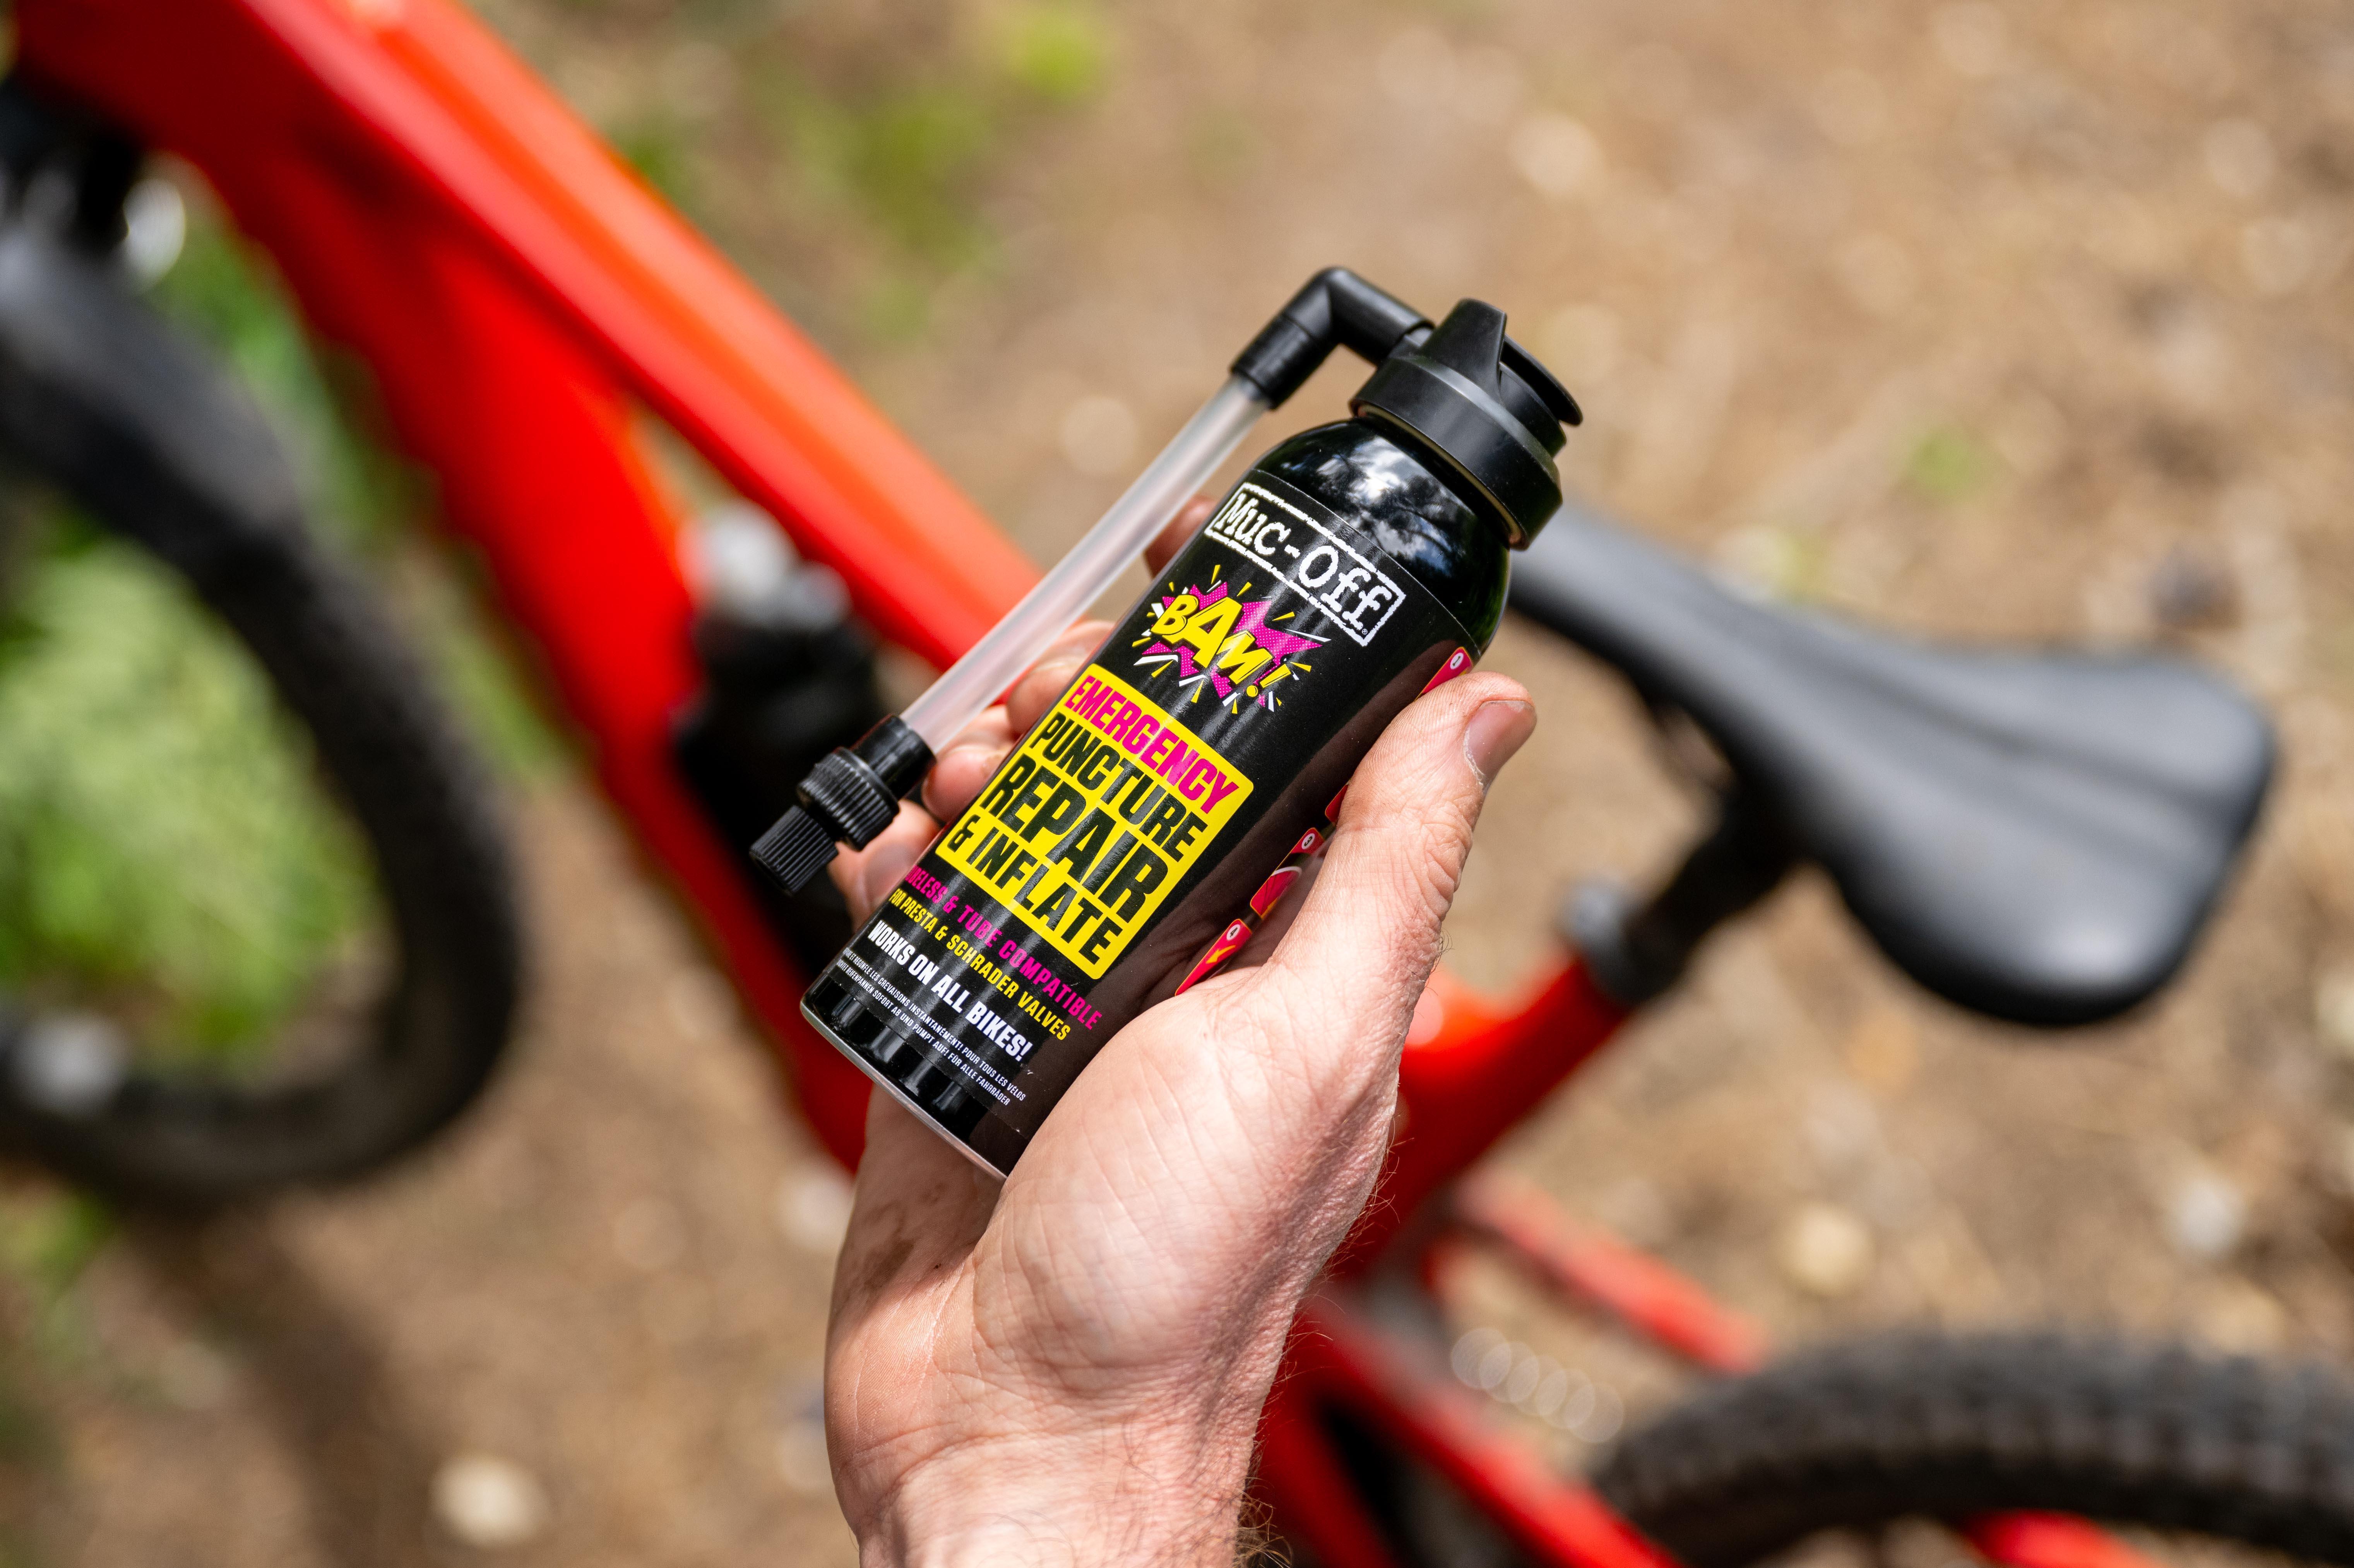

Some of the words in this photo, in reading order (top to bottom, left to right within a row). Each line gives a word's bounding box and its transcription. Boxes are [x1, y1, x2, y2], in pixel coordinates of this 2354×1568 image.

[1214, 492, 1392, 630] Muc-Off
[1150, 594, 1292, 698] BAM!
[1028, 711, 1209, 862] PUNCTURE
[1064, 675, 1239, 814] EMERGENCY
[947, 815, 980, 853] &
[966, 827, 1124, 965] INFLATE
[979, 753, 1169, 924] REPAIR
[853, 956, 873, 974] REGONFLE
[870, 970, 880, 981] LES
[878, 977, 911, 1007] CREVAISONS
[909, 1003, 964, 1051] INSTANTANÉMENT!
[961, 1047, 980, 1065] POUR
[979, 1061, 997, 1075] TOUS
[995, 1072, 1010, 1087] LES
[1007, 1082, 1026, 1101] VÉLOS
[868, 920, 916, 965] WORKS
[908, 954, 940, 986] ON
[931, 974, 970, 1013] ALL
[965, 1001, 1033, 1062] BIKES!
[889, 888, 907, 907] FOR
[899, 896, 938, 933] PRESTA
[935, 926, 948, 941] &
[947, 935, 1020, 999] SCHRADER
[1018, 991, 1071, 1041] VALVES
[943, 895, 959, 914] &
[957, 905, 1003, 948] TUBE
[998, 940, 1103, 1030] COMPATIBLE
[845, 967, 875, 994] REIFENPANNEN
[872, 990, 894, 1009] SOFORT
[891, 1007, 902, 1017] AB
[900, 1014, 914, 1027] UND
[912, 1024, 935, 1044] PUMPT
[933, 1041, 949, 1056] AUF!
[948, 1052, 963, 1066] FÜR
[960, 1063, 979, 1079] ALLE
[976, 1076, 1011, 1106] FAHRRÄDER
